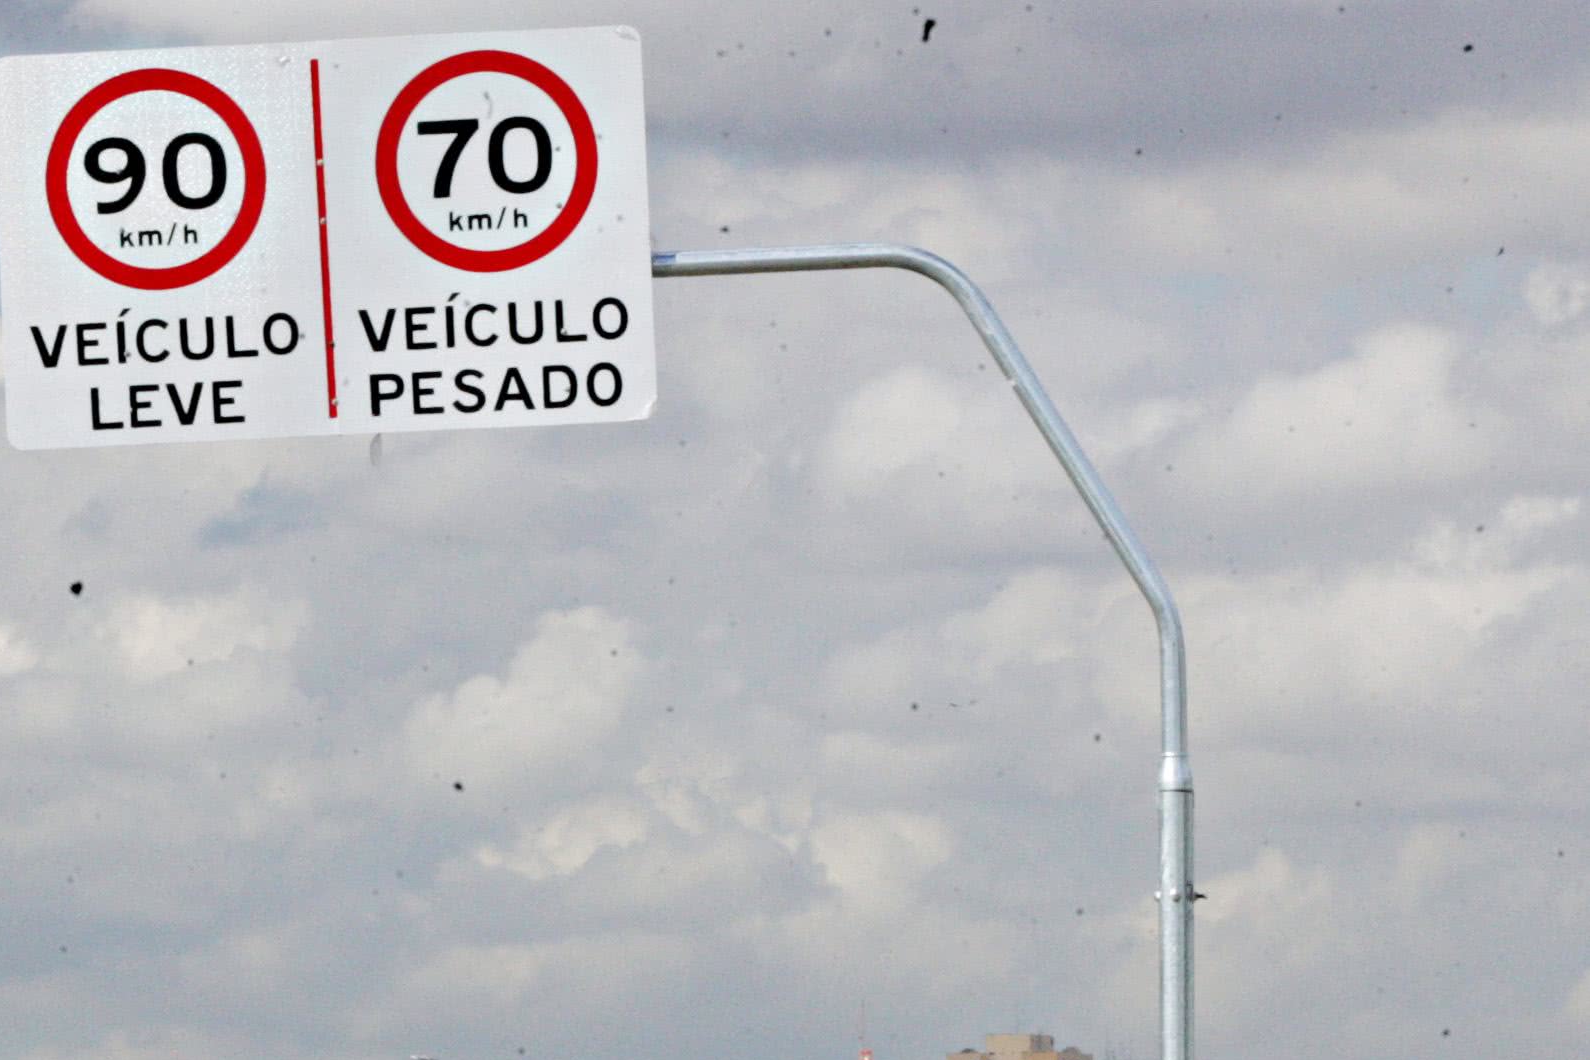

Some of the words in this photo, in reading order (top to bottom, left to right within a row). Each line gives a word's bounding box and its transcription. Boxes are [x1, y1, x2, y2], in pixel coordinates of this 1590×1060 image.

[83, 133, 227, 214] 90
[416, 116, 553, 199] 70
[119, 222, 199, 249] km/h
[448, 206, 529, 232] km/h
[30, 307, 300, 368] VEÍCULO
[358, 292, 629, 352] VEÍCULO
[90, 380, 246, 431] LEVE
[369, 361, 623, 417] PESADO
